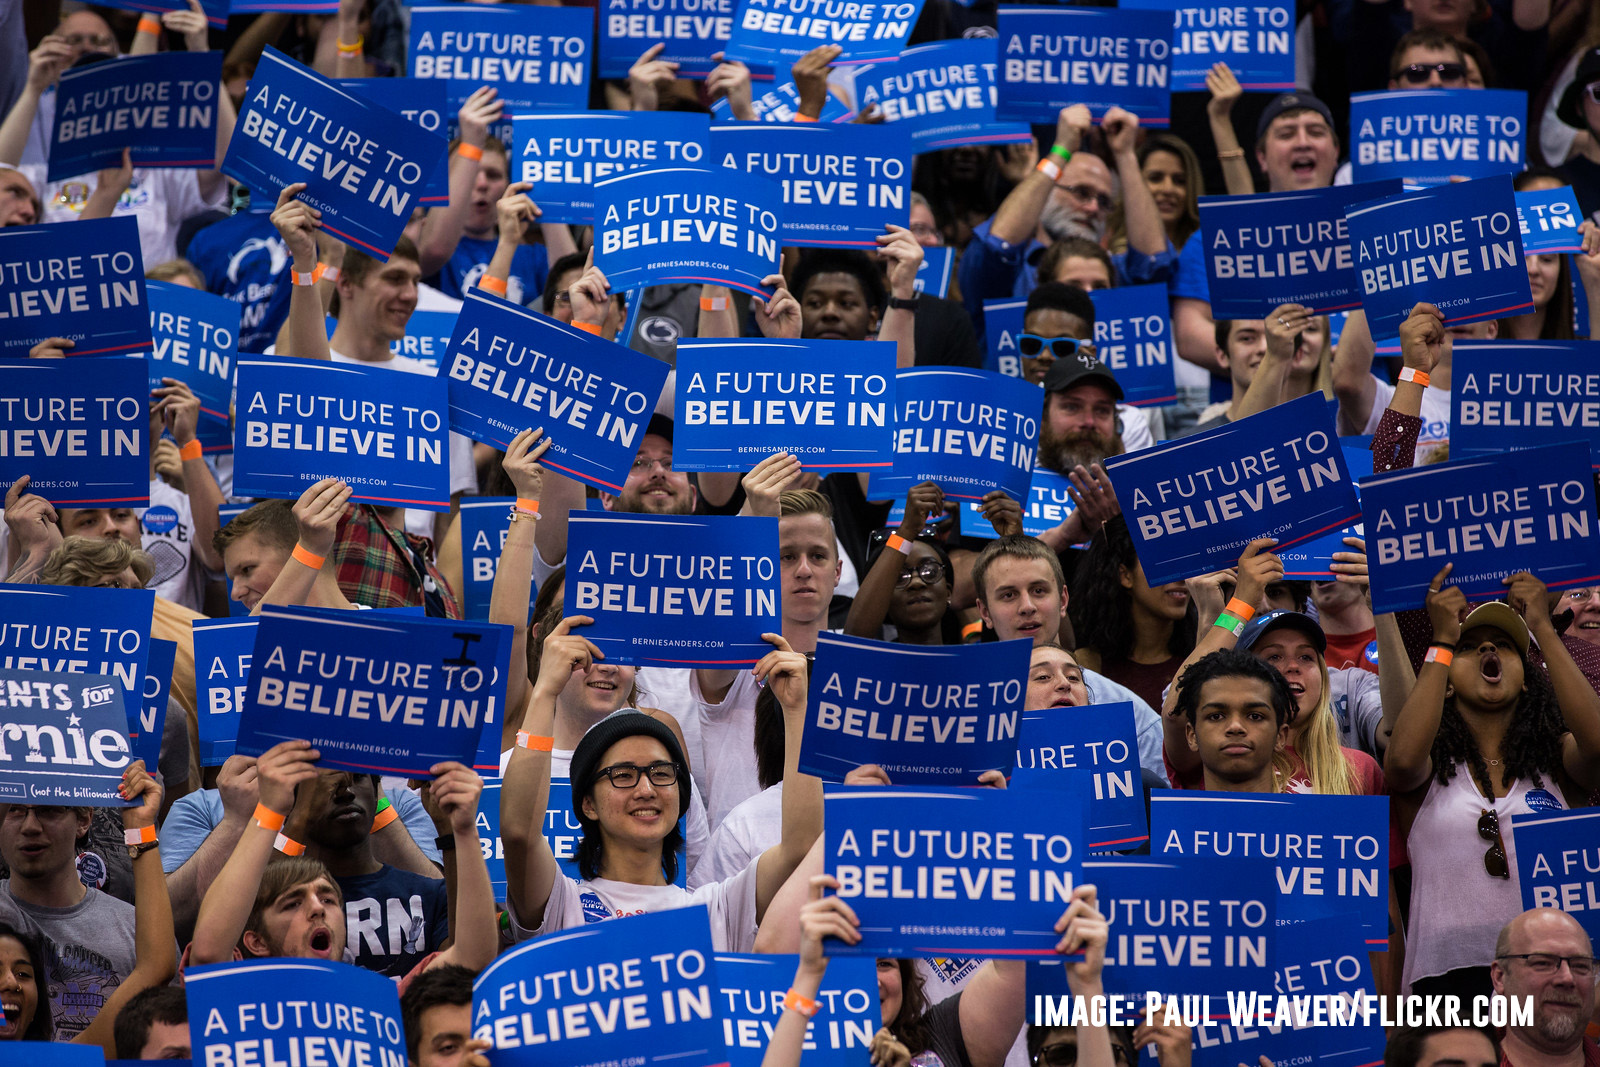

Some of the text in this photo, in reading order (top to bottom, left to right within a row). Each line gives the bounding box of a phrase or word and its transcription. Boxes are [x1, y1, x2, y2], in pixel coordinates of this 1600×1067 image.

[742, 8, 909, 41] BELIEVE IN
[881, 3, 915, 19] TO
[1253, 7, 1289, 28] TO
[608, 15, 733, 40] BELIEVE
[1257, 31, 1288, 54] IN
[417, 31, 585, 58] A FUTURE TO
[1007, 34, 1169, 60] A FUTURE TO
[415, 55, 583, 85] BELIEVE IN
[882, 64, 978, 96] FUTURE
[1005, 59, 1167, 87] BELIEVE IN
[63, 81, 213, 116] A FUTURE TO
[58, 106, 211, 143] BELIEVE IN
[253, 85, 421, 184] A FUTURE TO
[1359, 114, 1520, 138] A FUTURE TO
[242, 109, 411, 216] BELIEVE IN
[523, 138, 703, 162] A FUTURE TO
[1359, 138, 1519, 165] BELIEVE IN
[747, 153, 904, 179] FUTURE TO
[868, 184, 903, 209] IN
[603, 194, 777, 232] A FUTURE TO
[1530, 202, 1576, 231] TO IN
[602, 219, 776, 263] BELIEVE IN
[1213, 229, 1231, 249] A
[1360, 212, 1510, 263] A FUTURE TO
[91, 251, 134, 276] TO
[647, 260, 729, 270] BERNIESANDERS.COM
[1214, 244, 1354, 278] BELIEVE
[1361, 241, 1517, 295] BELIEVE IN
[100, 280, 139, 308] IN
[198, 321, 232, 349] TO
[1129, 315, 1164, 338] TO
[199, 348, 230, 380] IN
[1135, 341, 1166, 366] IN
[461, 327, 479, 351] A
[488, 335, 602, 398] FUTURE
[610, 382, 647, 414] TO
[687, 372, 886, 396] A FUTURE TO
[1462, 373, 1479, 394] A
[95, 397, 140, 421] TO
[248, 391, 441, 432] A FUTURE TO
[449, 353, 593, 430] BELIEVE
[596, 412, 638, 448] IN
[685, 400, 885, 427] BELIEVE IN
[904, 400, 1036, 440] FUTURE TO
[101, 429, 140, 456] IN
[246, 421, 441, 465] BELIEVE IN
[1011, 441, 1033, 472] IN
[917, 474, 997, 488] BERNIESANDERS.COM
[1133, 431, 1328, 510] A FUTURE TO
[1136, 457, 1341, 541] BELIEVE IN
[1376, 480, 1585, 532] A FUTURE TO
[1206, 523, 1295, 555] BERNIESANDERS.COM
[1377, 510, 1589, 567] BELIEVE IN
[578, 550, 774, 581] A FUTURE TO
[576, 581, 776, 617] BELIEVE IN
[100, 628, 140, 654] TO
[632, 637, 724, 648] BERNIESANDERS.COM
[264, 646, 483, 692] A FUTURE TO
[81, 684, 114, 709] for
[257, 676, 479, 728] BELIEVE IN
[822, 672, 1021, 708] A FUTURE TO
[816, 701, 1018, 743] BELIEVE IN
[0, 712, 130, 768] rnie
[312, 738, 410, 757] BERNIESANDERS.COM
[1084, 740, 1129, 765] TO
[30, 784, 124, 799] (not the billionaire
[1093, 770, 1134, 800] IN
[837, 829, 1072, 863] A FUTURE TO
[1163, 829, 1379, 860] A FUTURE TO
[834, 864, 1072, 902] BELIEVE IN
[1338, 868, 1378, 897] IN
[1219, 900, 1267, 928] TO
[900, 925, 1006, 936] BERNIESANDERS.COM
[1224, 935, 1266, 967] IN
[1310, 955, 1361, 986] TO
[475, 949, 705, 1026] A FUTURE TO
[819, 989, 870, 1014] TO
[662, 985, 712, 1024] IN
[204, 1001, 400, 1045] A FUTURE TO
[829, 1020, 873, 1049] IN
